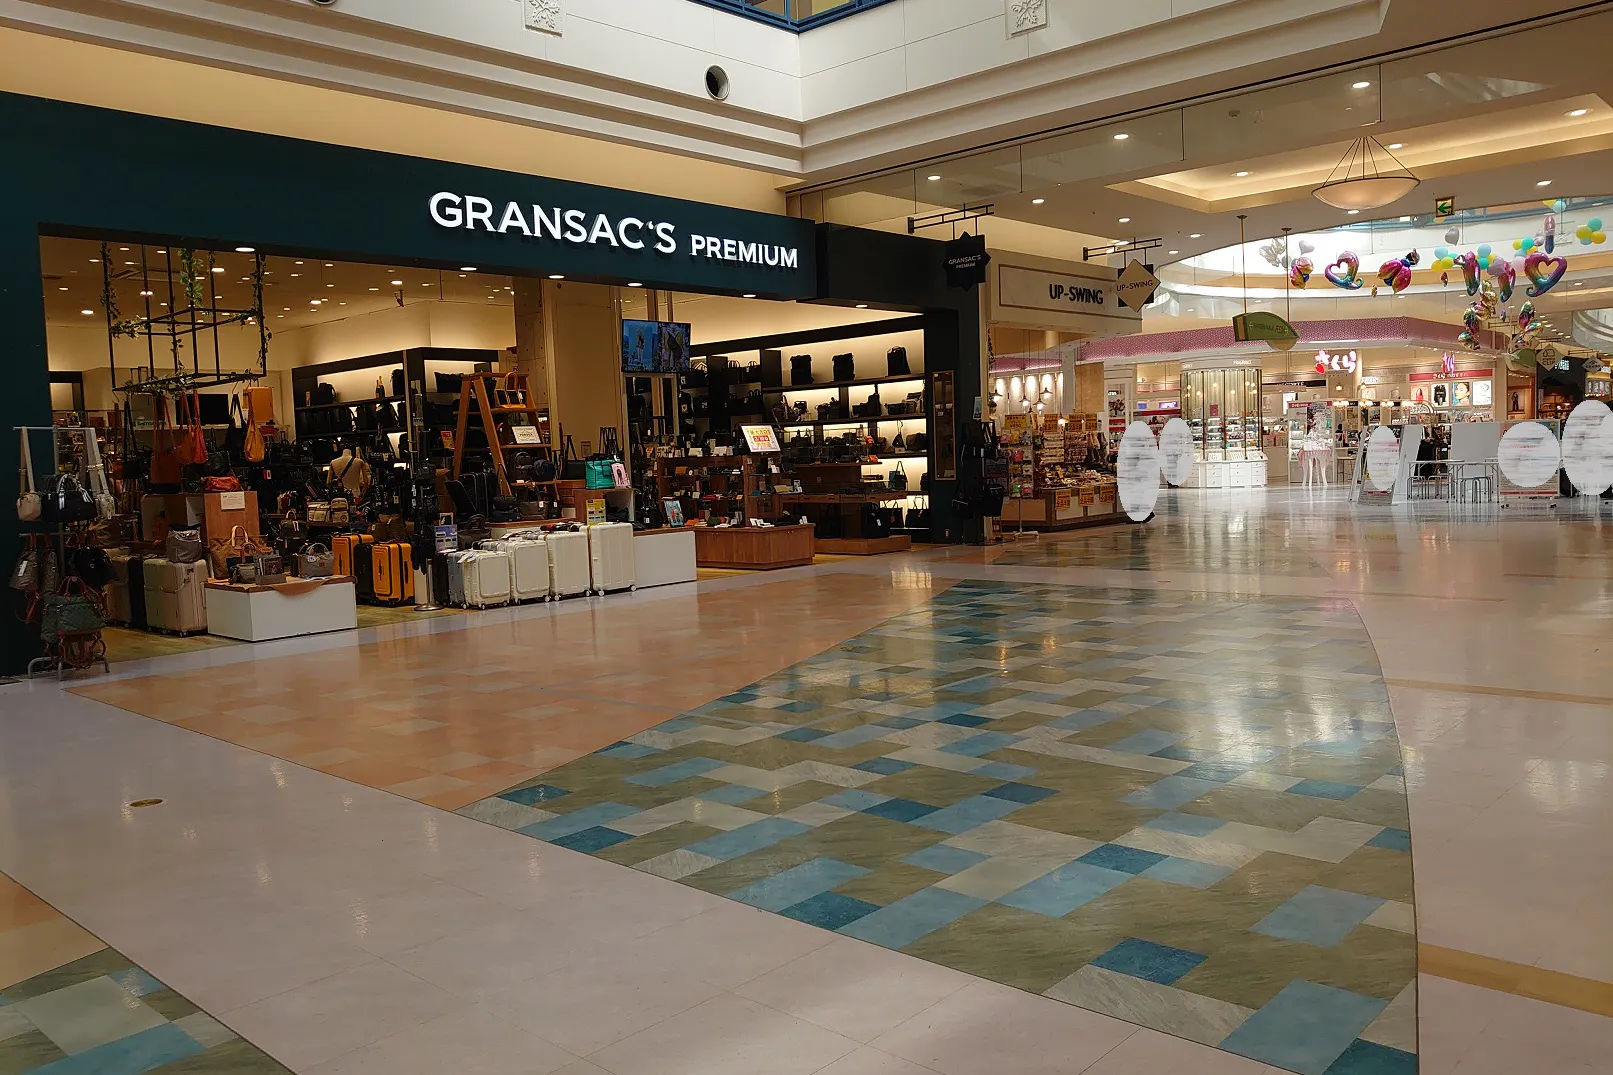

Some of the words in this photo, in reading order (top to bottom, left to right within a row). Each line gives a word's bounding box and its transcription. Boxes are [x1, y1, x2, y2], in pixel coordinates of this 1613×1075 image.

[428, 191, 677, 254] GRANSAC'S
[689, 234, 798, 269] PREMIUM
[948, 254, 982, 265] GRANSAC'S
[1049, 284, 1103, 304] UP-SWING
[1116, 280, 1154, 292] UP-SWING
[1314, 350, 1357, 374] さくら
